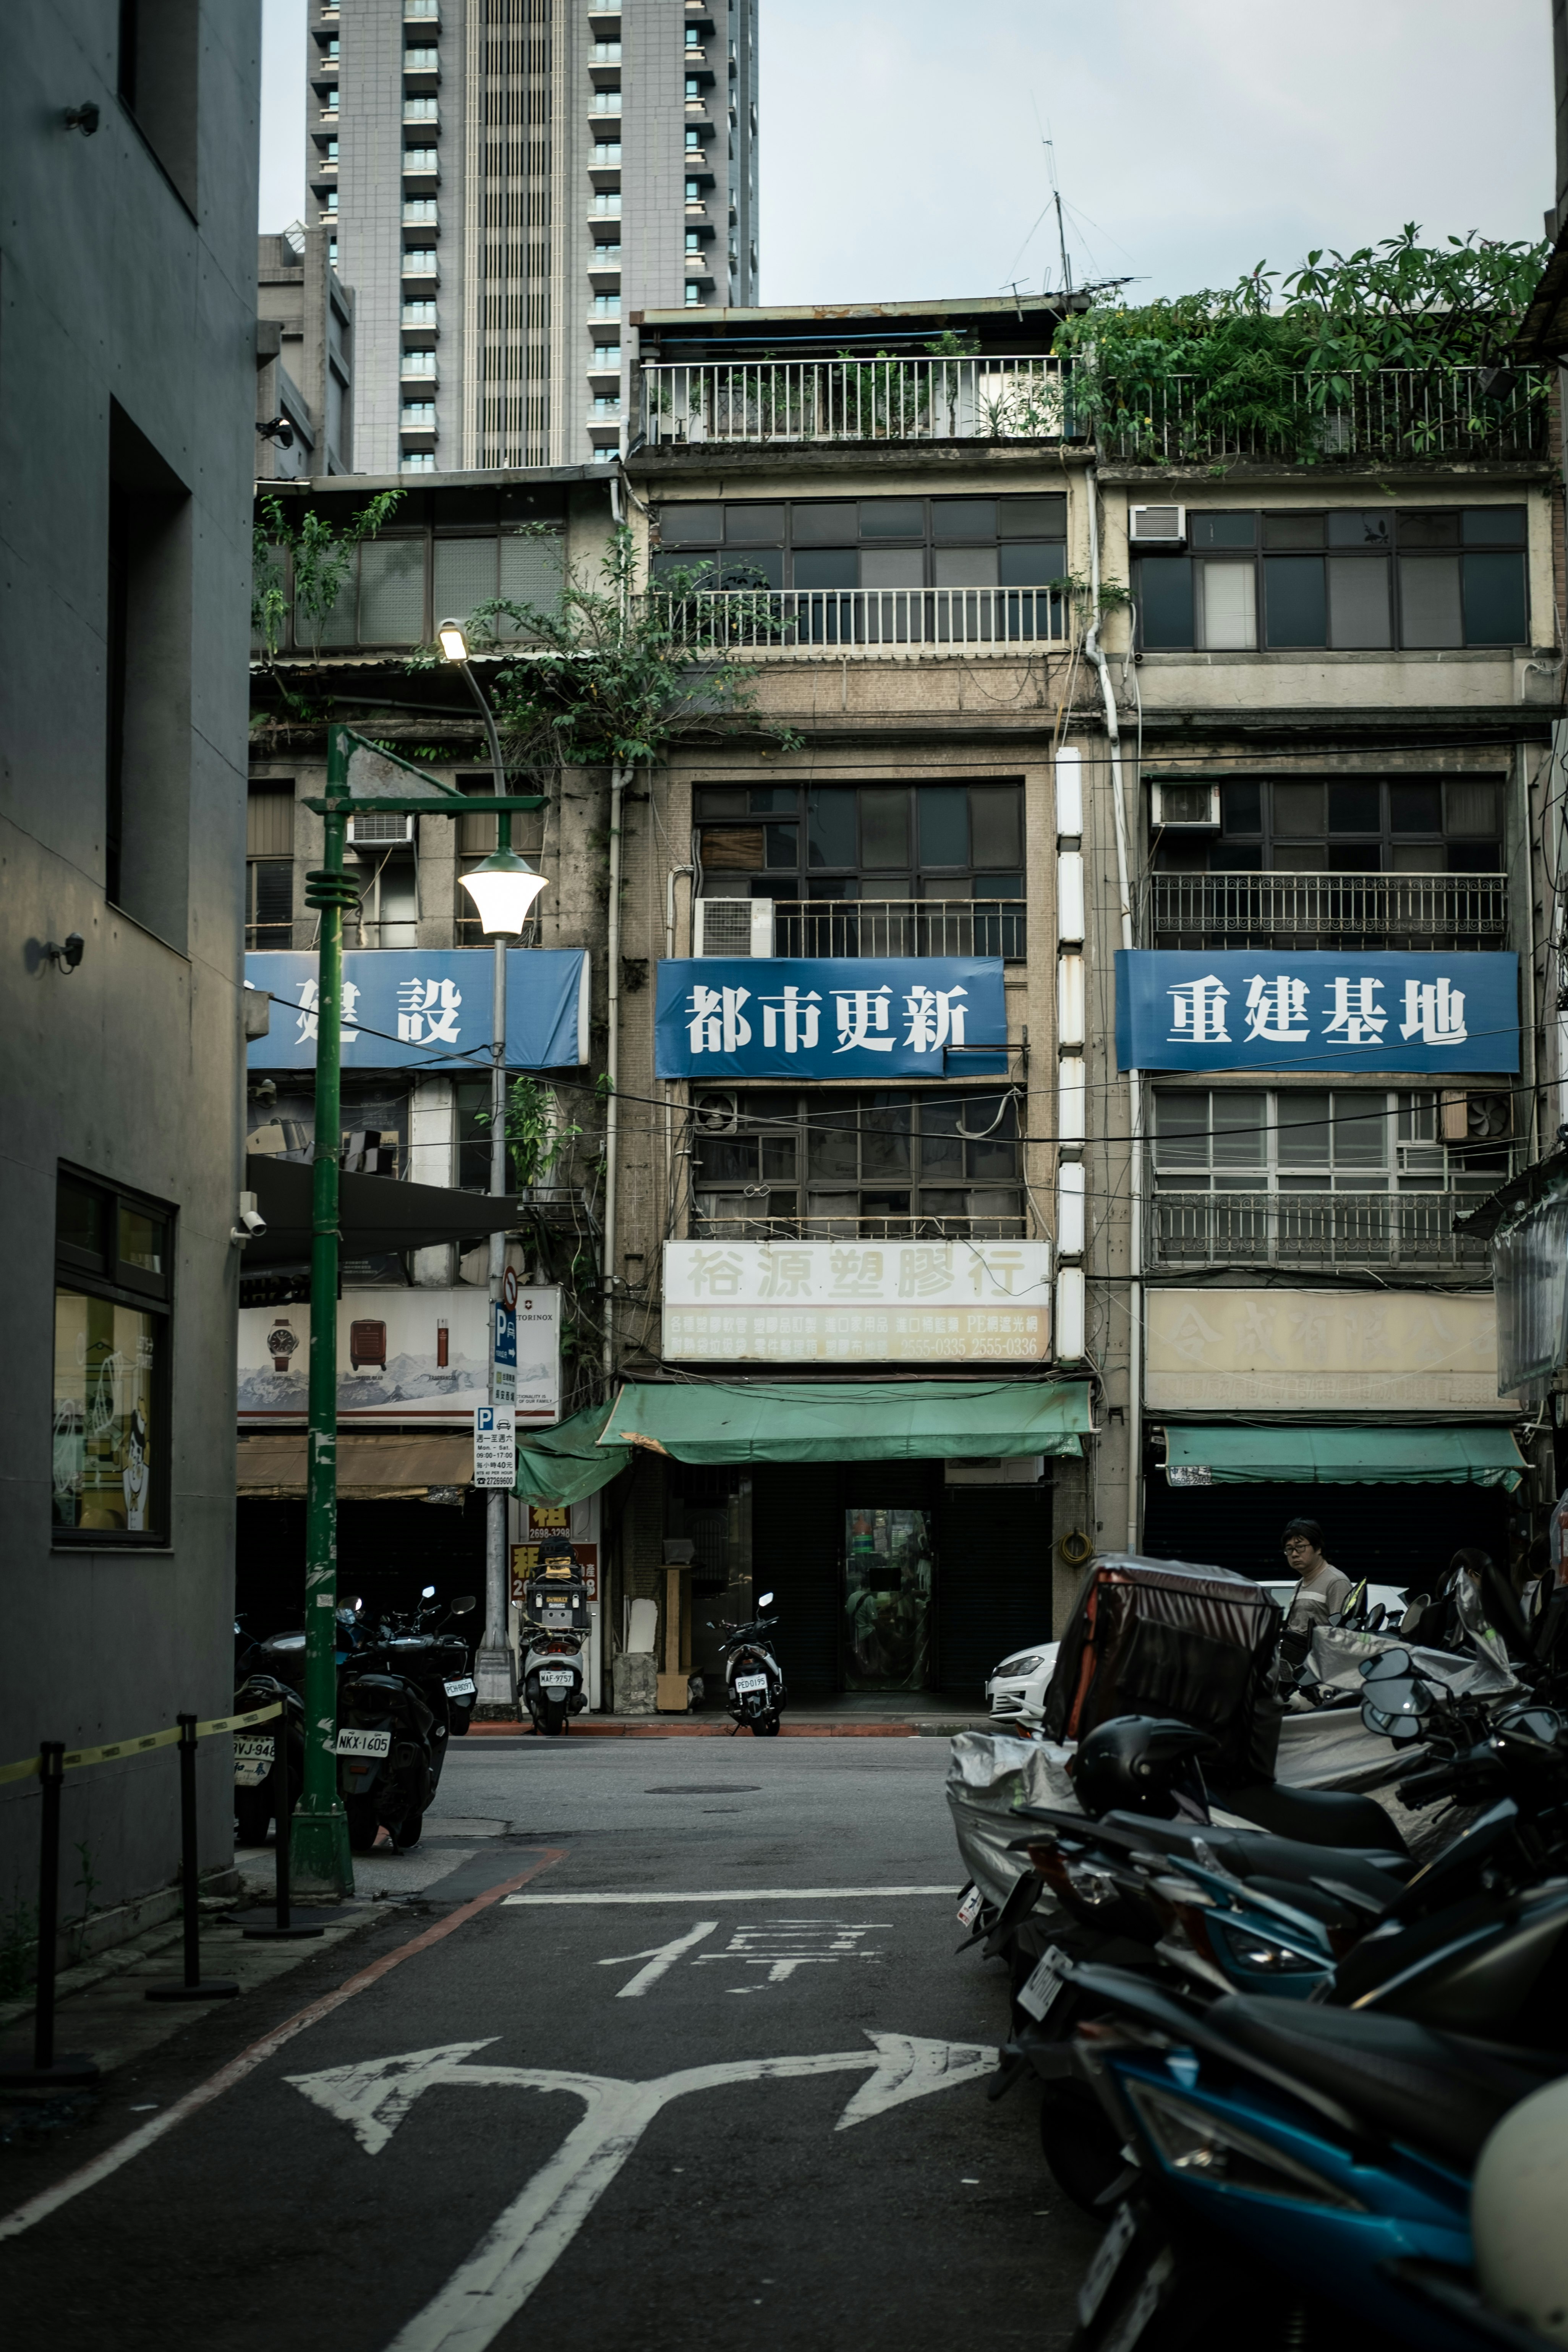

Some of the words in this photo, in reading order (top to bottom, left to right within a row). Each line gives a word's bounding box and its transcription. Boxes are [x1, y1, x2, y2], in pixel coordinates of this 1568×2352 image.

[244, 977, 462, 1045] 建設
[684, 985, 969, 1053] 都市更新
[1166, 974, 1468, 1046] 重建基地
[687, 1247, 1025, 1299] 裕源塑膠行
[496, 1309, 507, 1346] P
[670, 1316, 747, 1333] 各種塑膠軟管
[753, 1316, 817, 1334] 塑膠品訂製
[825, 1316, 888, 1333] 進口家用品
[967, 1315, 1038, 1333] PE網遮光網
[670, 1337, 747, 1354] 耐熱袋垃圾袋
[754, 1338, 818, 1356] 零件整理箱
[901, 1338, 966, 1357] 2555-0335
[972, 1338, 1037, 1356] 2555-0336
[479, 1409, 492, 1429] P
[476, 1434, 513, 1443] 週一至週六
[532, 1508, 567, 1527] 租
[530, 1528, 570, 1539] 2698-3298
[737, 1678, 765, 1689] PED-0195
[339, 1735, 388, 1751] NKX-1605
